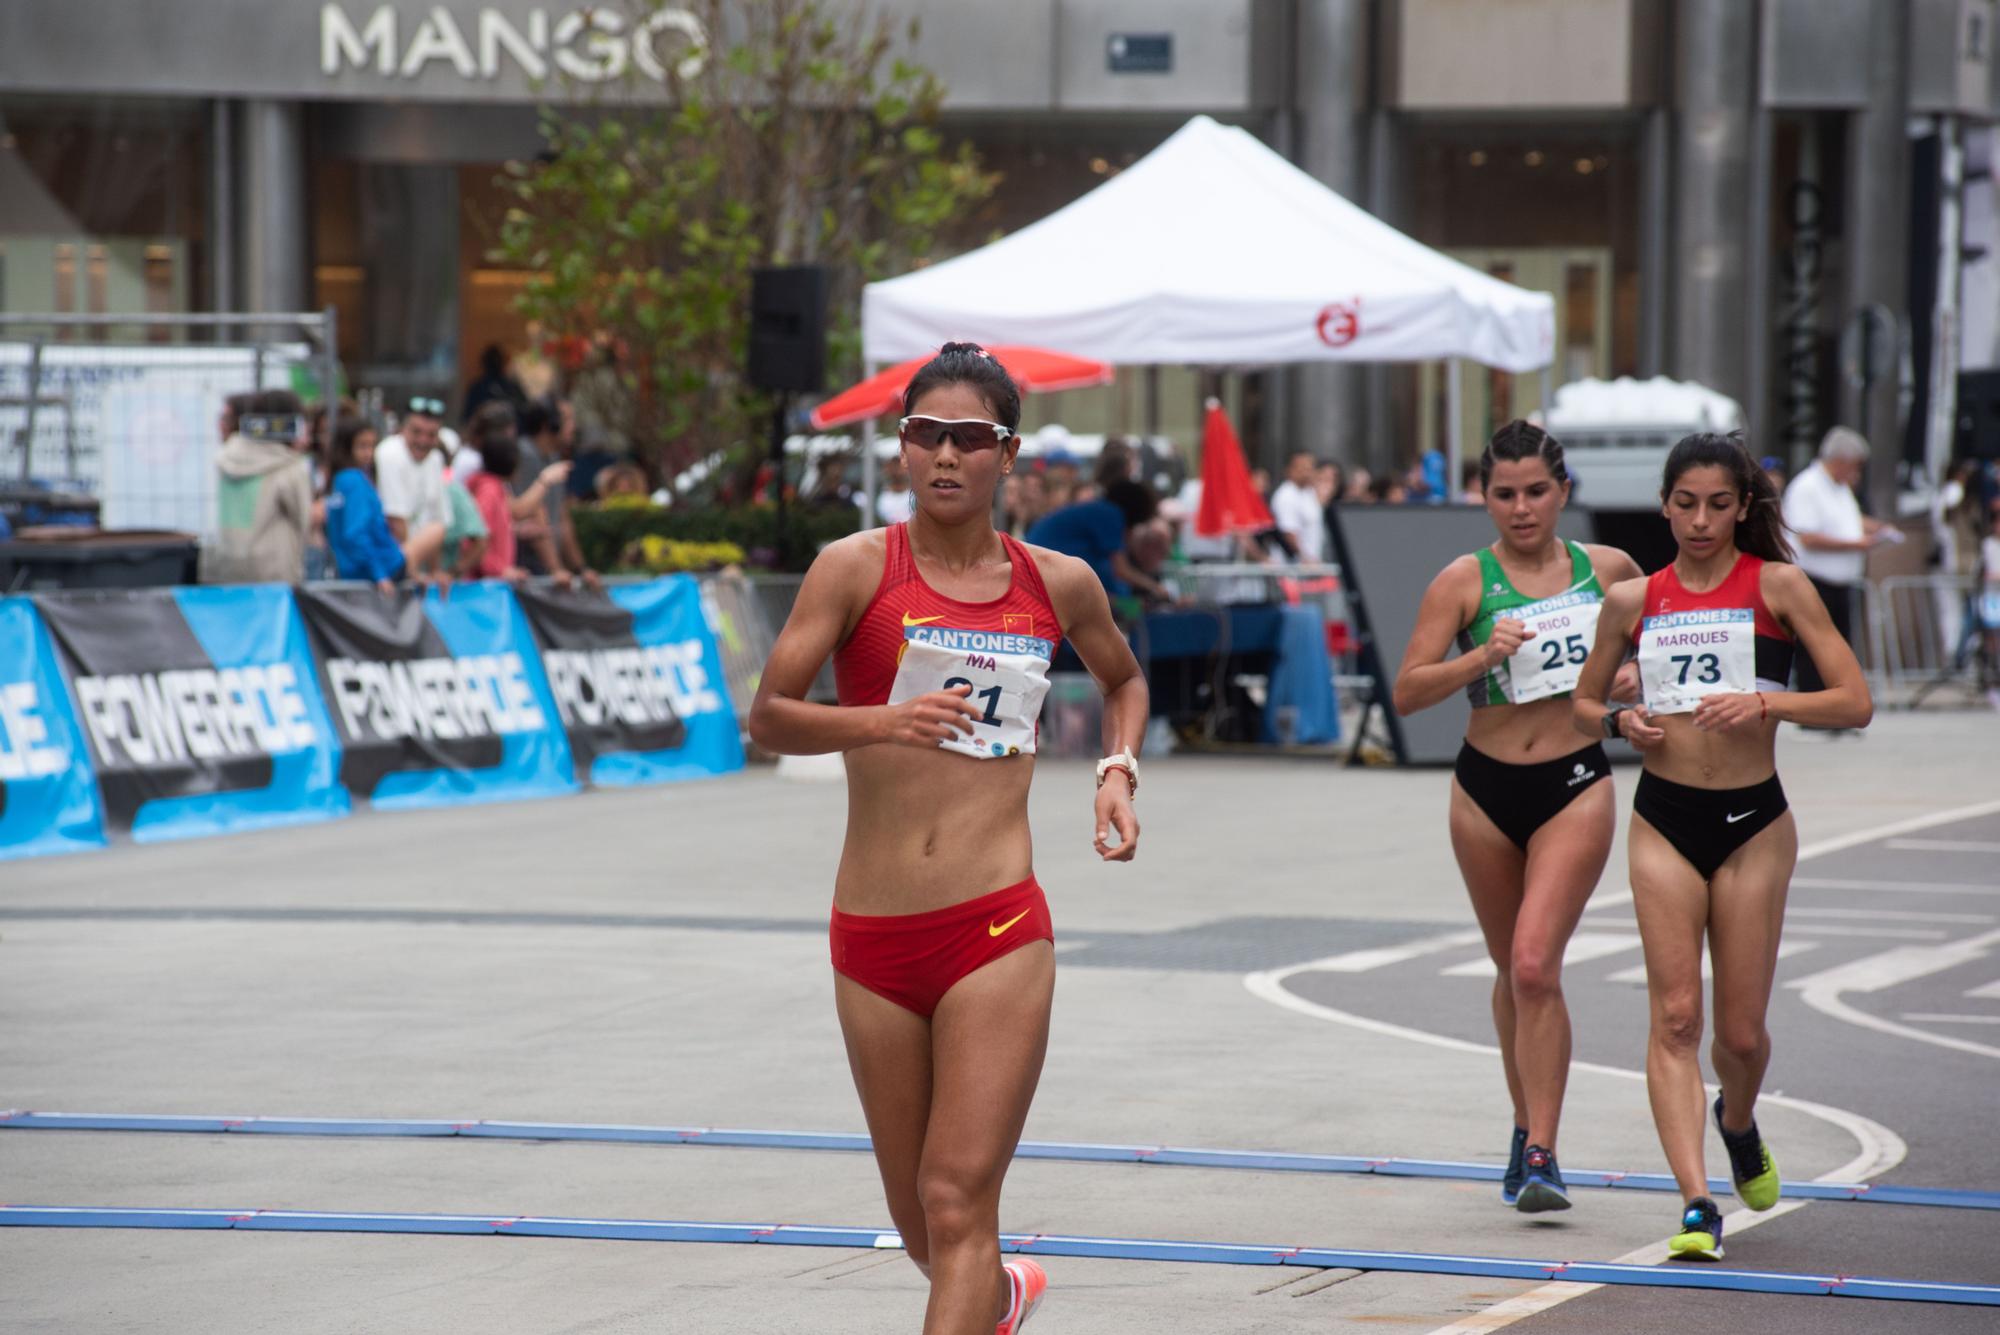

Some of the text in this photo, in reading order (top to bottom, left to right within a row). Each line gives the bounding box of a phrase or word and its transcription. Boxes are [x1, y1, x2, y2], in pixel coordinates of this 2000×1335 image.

[321, 3, 708, 81] MANGO
[1538, 616, 1571, 632] RICO
[1657, 631, 1729, 647] MARQUES
[914, 629, 1049, 657] CANTONES23
[1540, 634, 1588, 671] 25
[966, 653, 996, 672] MA
[1671, 653, 1721, 685] 73
[327, 652, 545, 741] POWERADE
[543, 639, 721, 727] POWERADE
[75, 663, 316, 767] POWERADE
